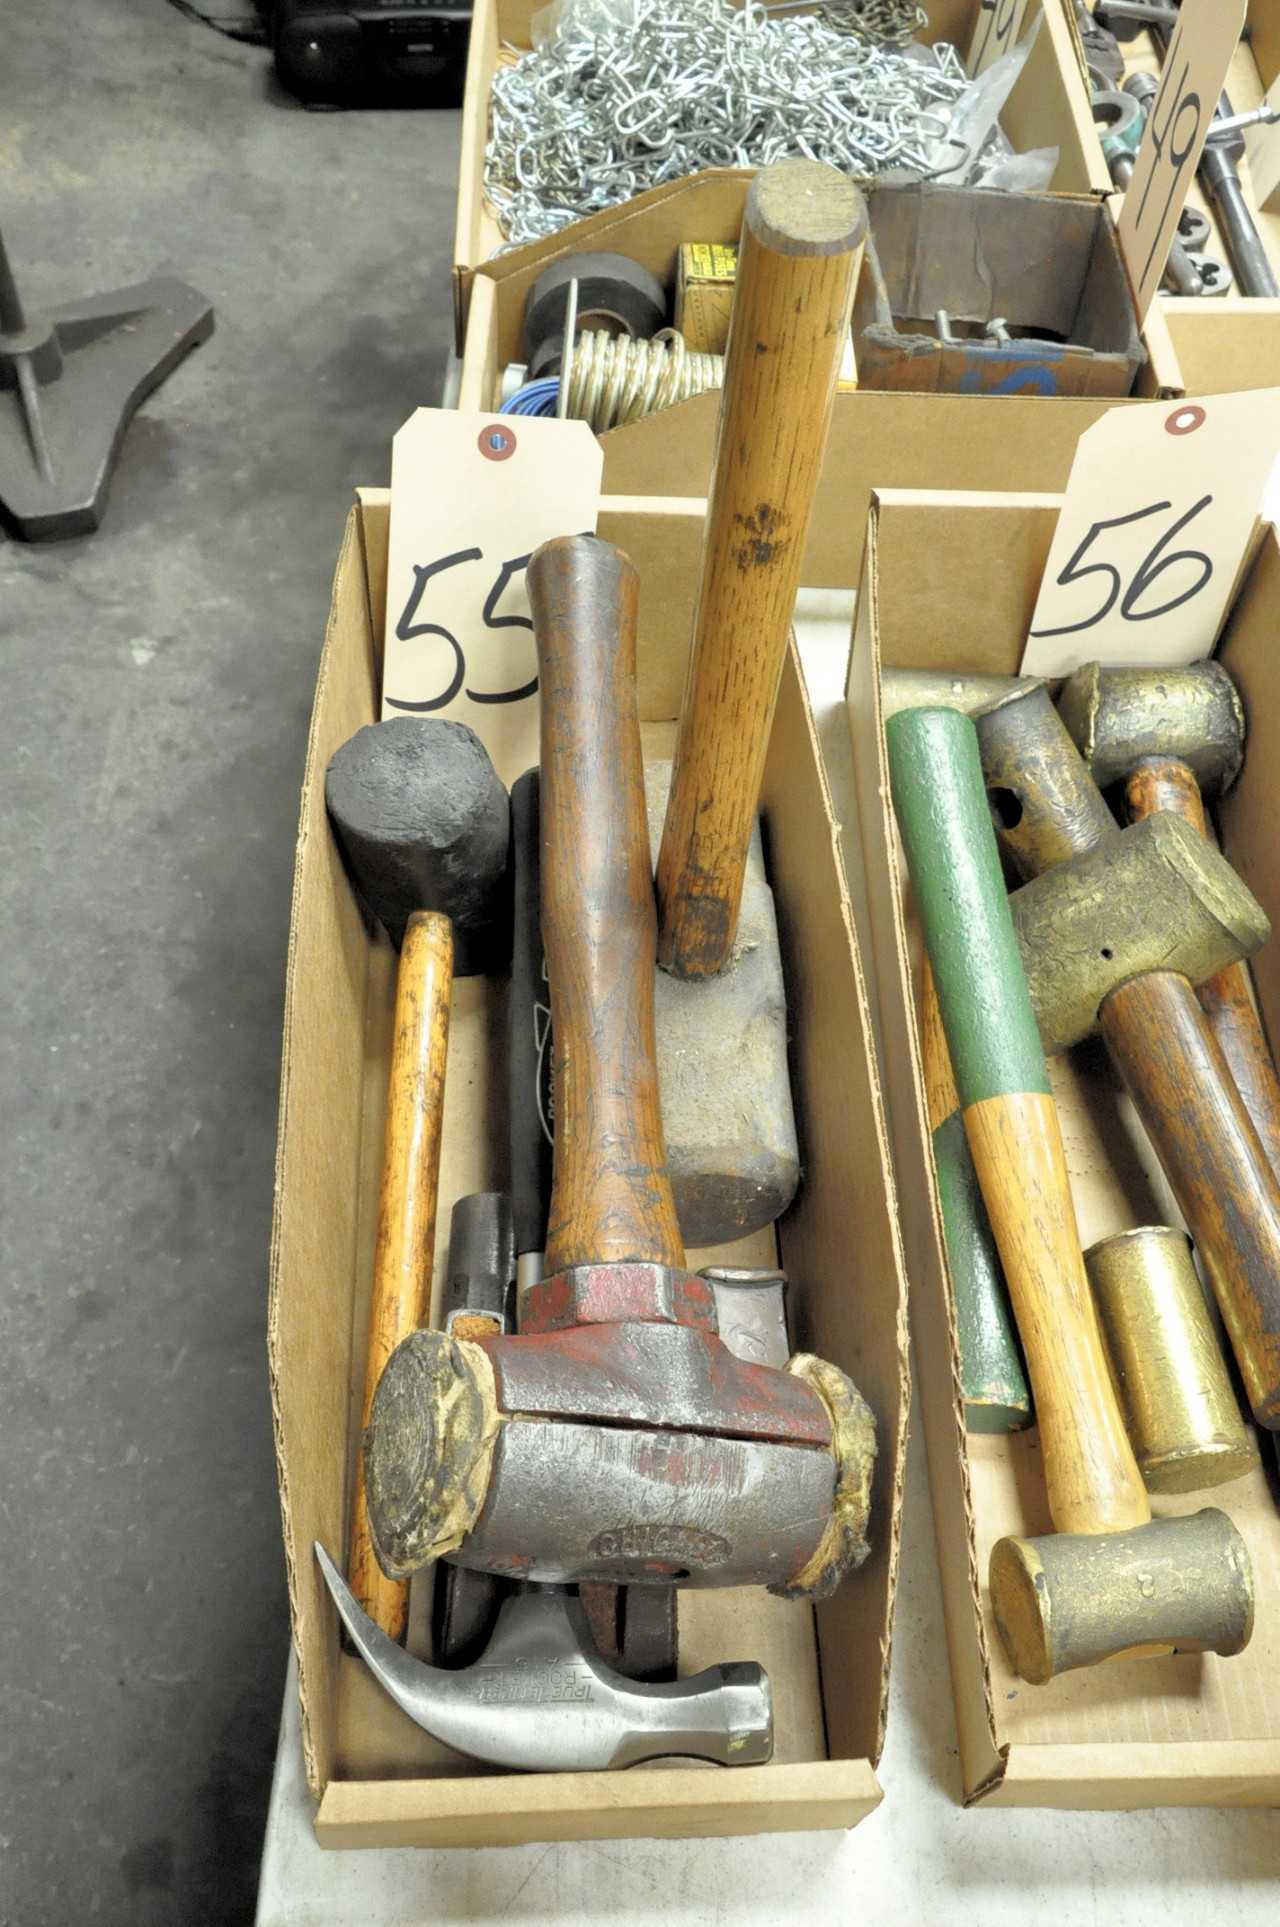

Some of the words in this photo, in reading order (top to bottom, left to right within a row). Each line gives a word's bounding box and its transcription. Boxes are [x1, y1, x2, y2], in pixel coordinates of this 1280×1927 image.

[1136, 26, 1200, 293] 49
[385, 531, 594, 712] 55
[1030, 494, 1213, 638] 56
